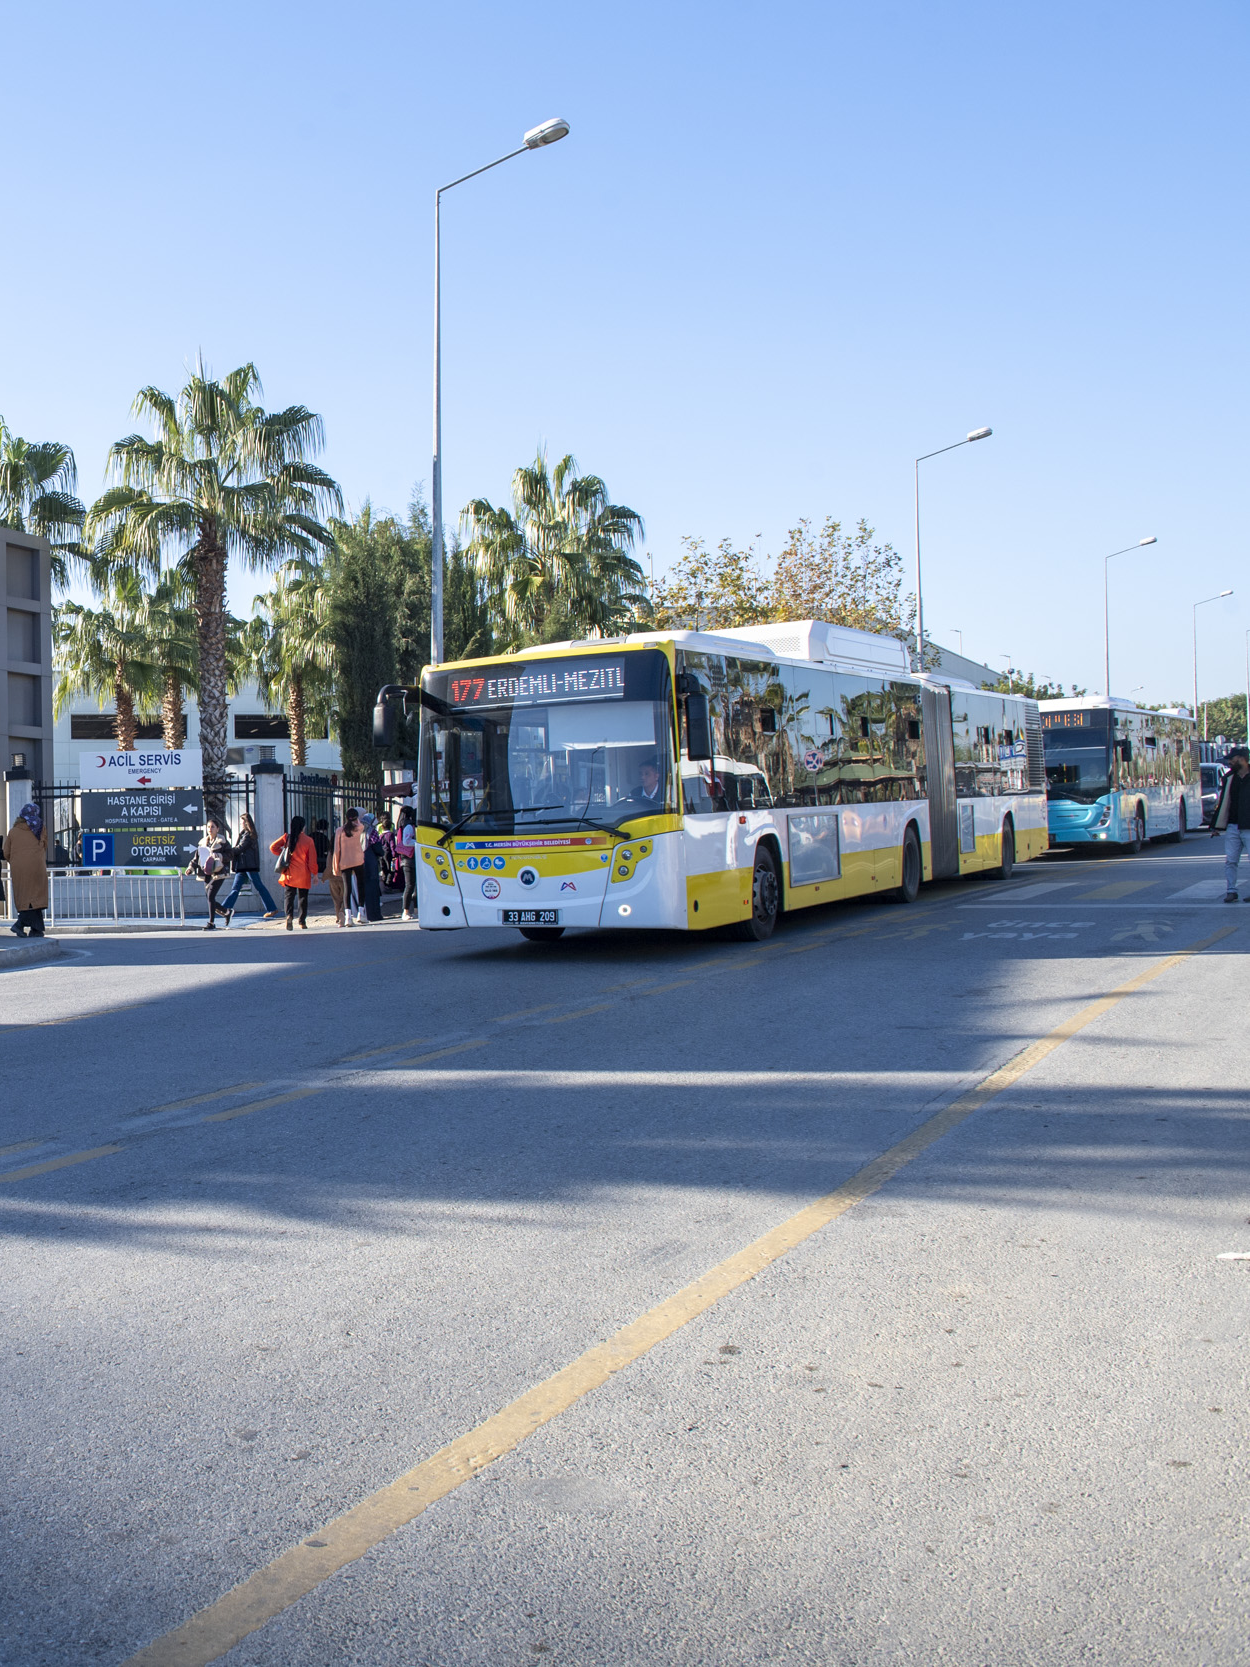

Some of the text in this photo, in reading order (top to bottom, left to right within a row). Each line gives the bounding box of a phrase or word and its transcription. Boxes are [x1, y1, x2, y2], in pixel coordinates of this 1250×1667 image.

[451, 678, 485, 702] 177
[108, 751, 182, 768] ACİL SERVİS
[107, 793, 176, 807] HASTANE GİRİŞİ
[121, 806, 162, 817] A KAPISI
[132, 835, 176, 846] ÜCRETSİZ
[92, 839, 107, 862] P
[131, 846, 178, 856] OTOPARK
[508, 911, 555, 922] 33 AHG 209
